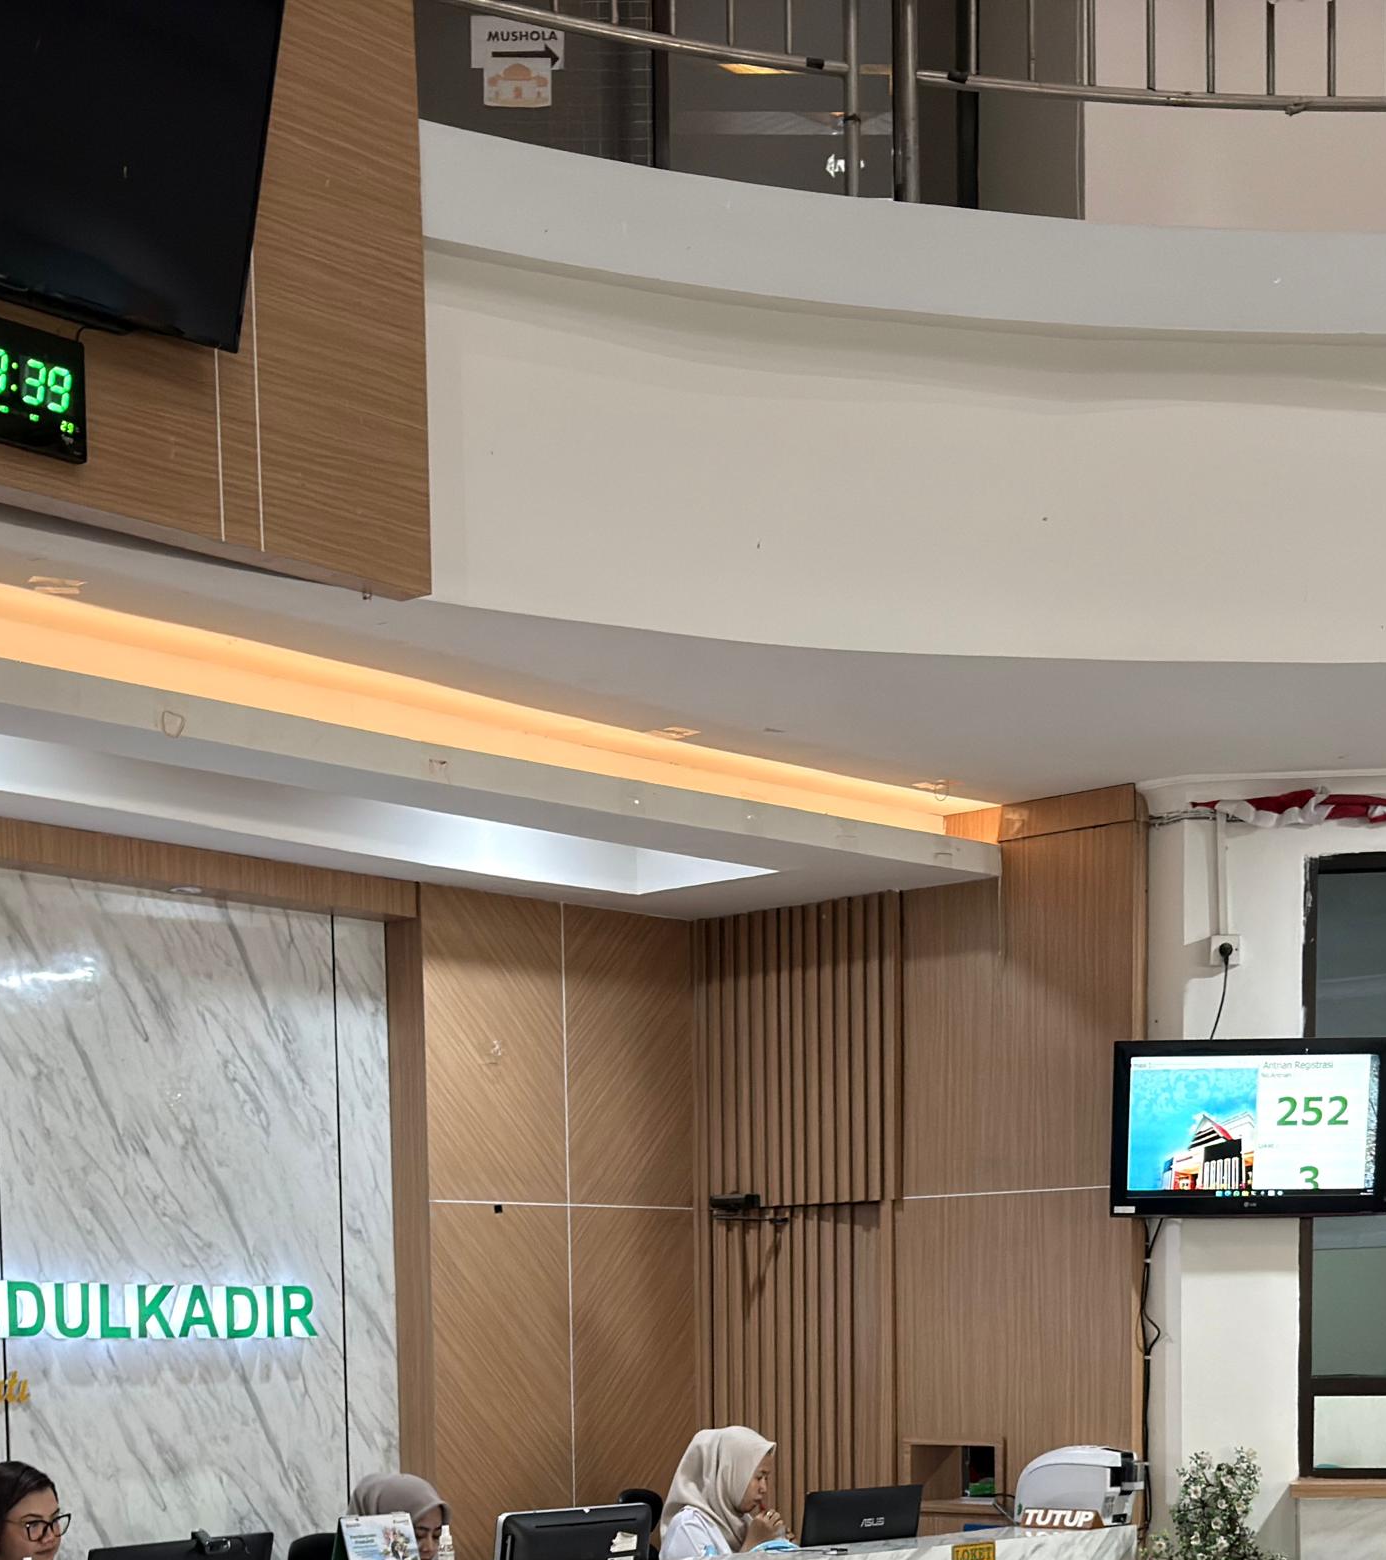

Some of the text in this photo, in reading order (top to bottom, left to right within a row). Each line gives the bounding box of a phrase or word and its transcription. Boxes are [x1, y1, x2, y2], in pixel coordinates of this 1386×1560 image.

[486, 30, 558, 42] MUSHOLA
[1276, 1095, 1349, 1127] 252
[1299, 1165, 1320, 1190] 3
[860, 1516, 885, 1528] ASUS
[1024, 1508, 1095, 1528] TUTUP
